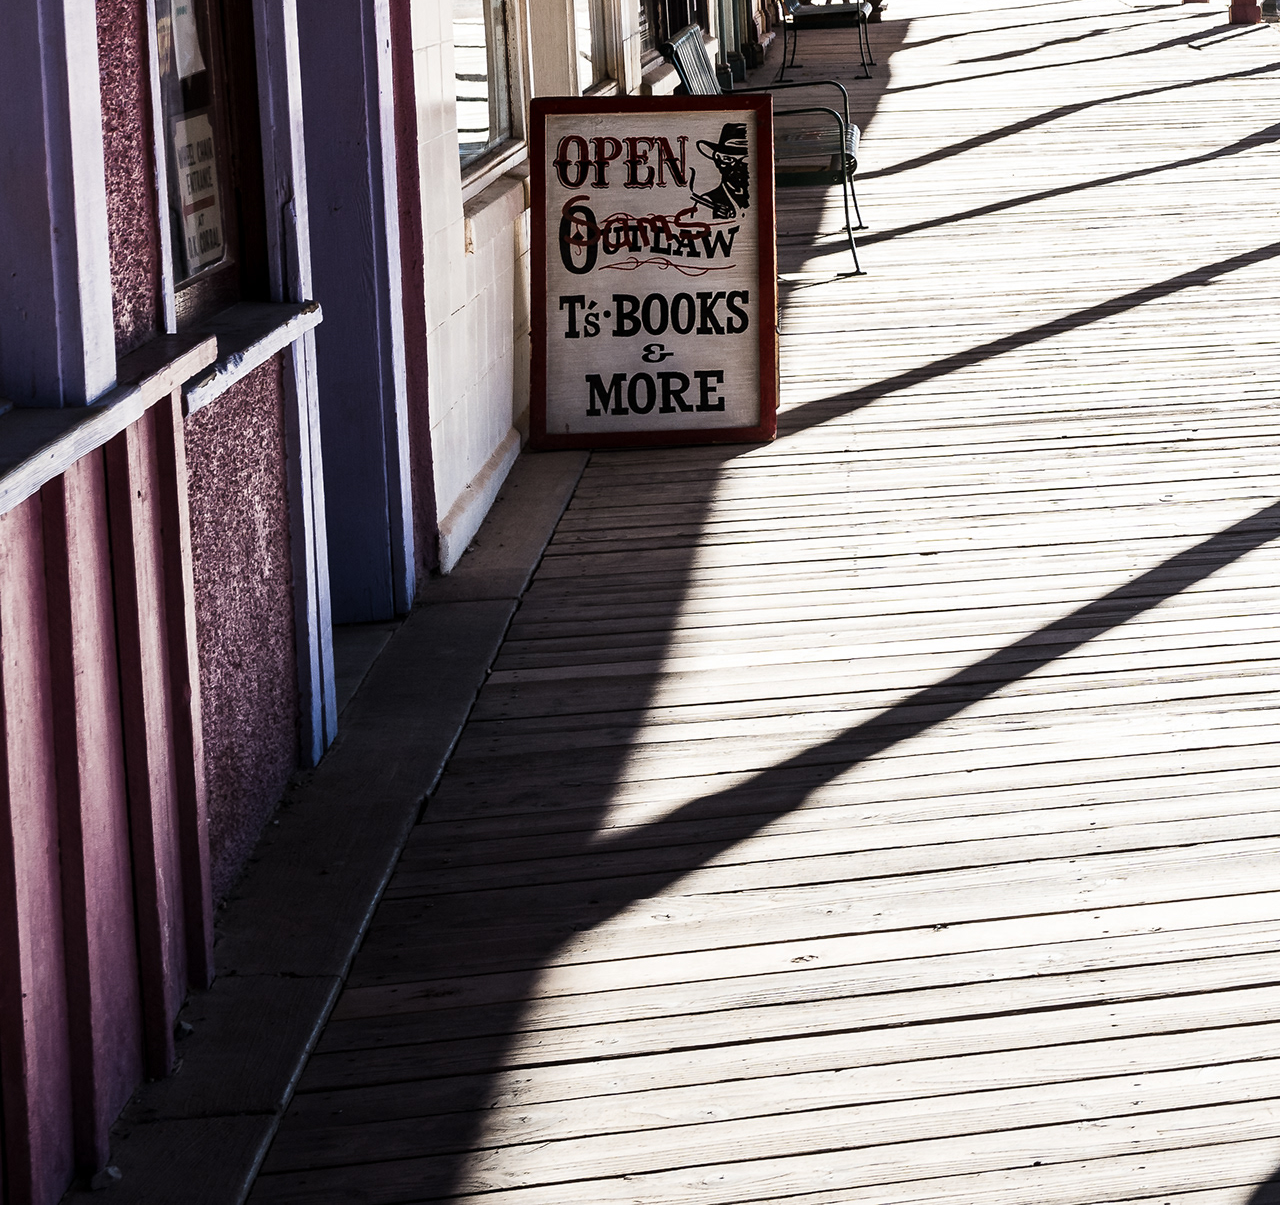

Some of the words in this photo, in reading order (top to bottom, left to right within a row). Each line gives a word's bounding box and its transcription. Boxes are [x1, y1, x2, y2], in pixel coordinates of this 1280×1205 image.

[554, 134, 690, 190] OPEN
[611, 289, 749, 338] BOOKS
[641, 342, 674, 364] &
[585, 369, 726, 417] MORE
